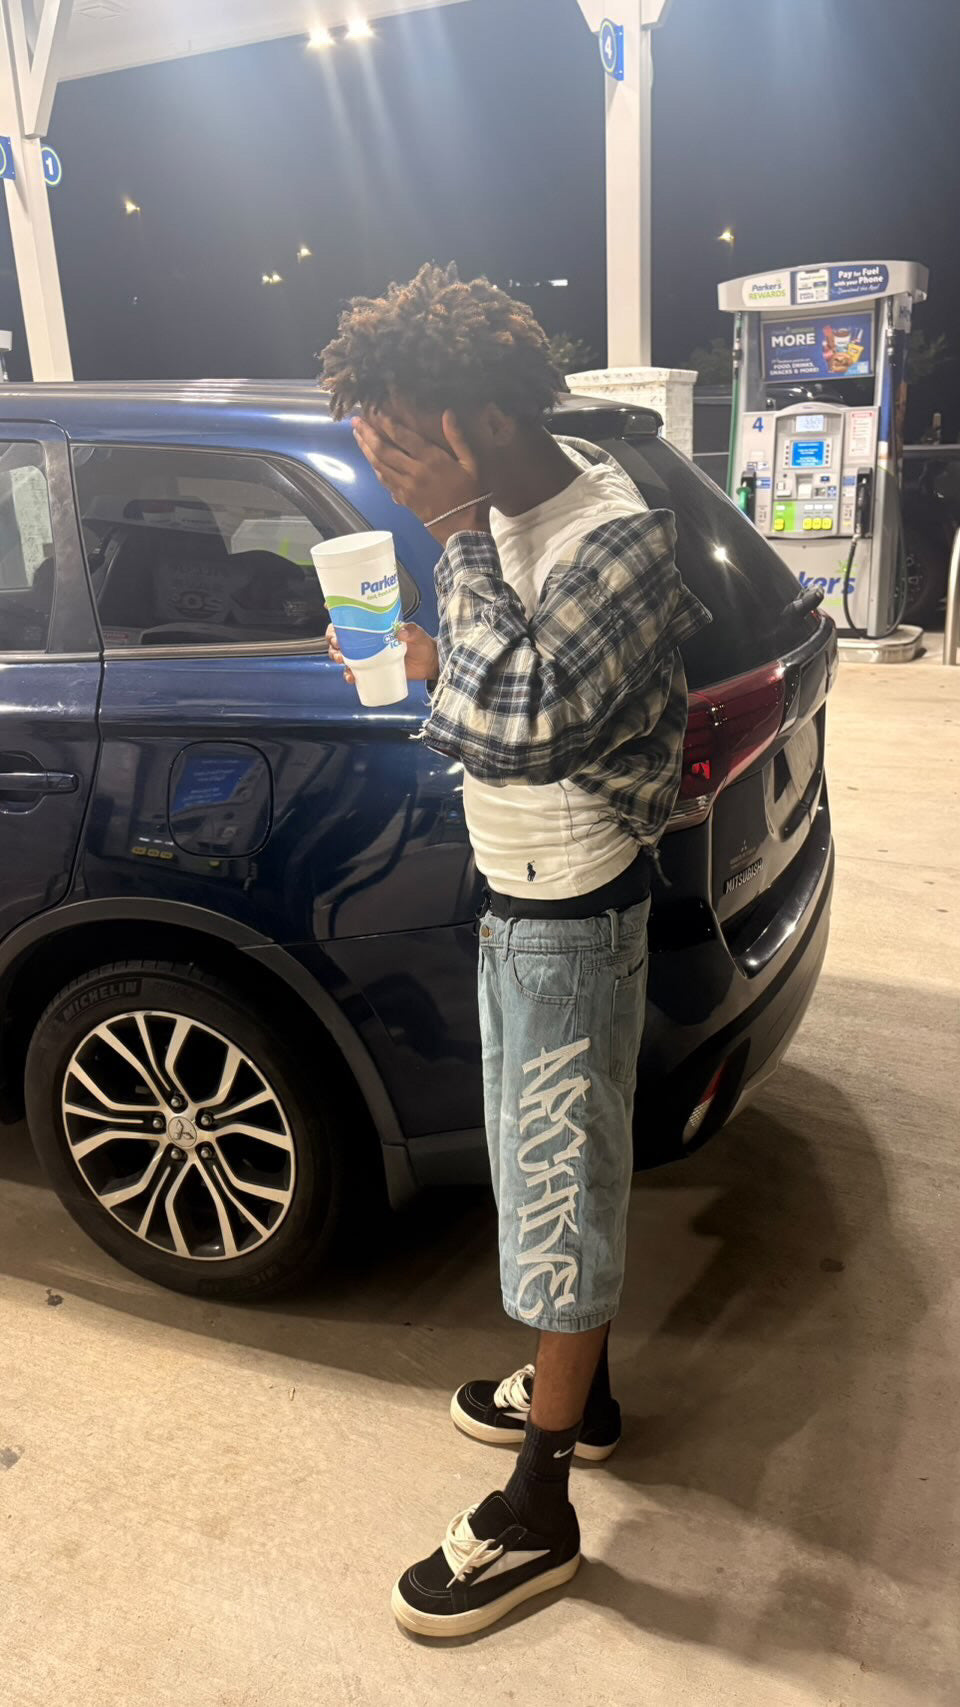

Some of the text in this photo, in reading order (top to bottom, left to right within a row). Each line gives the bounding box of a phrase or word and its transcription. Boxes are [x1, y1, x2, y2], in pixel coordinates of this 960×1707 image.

[605, 35, 612, 59] 4
[46, 157, 54, 175] 1
[838, 270, 852, 280] Pay
[862, 266, 879, 276] Fuel
[858, 275, 884, 284] Phone
[749, 290, 786, 300] REWARDS
[771, 332, 816, 348] MORE
[752, 416, 764, 433] 4
[361, 573, 398, 595] Parker
[726, 859, 767, 894] MITSUBISHI
[63, 981, 137, 1022] MICHELIN
